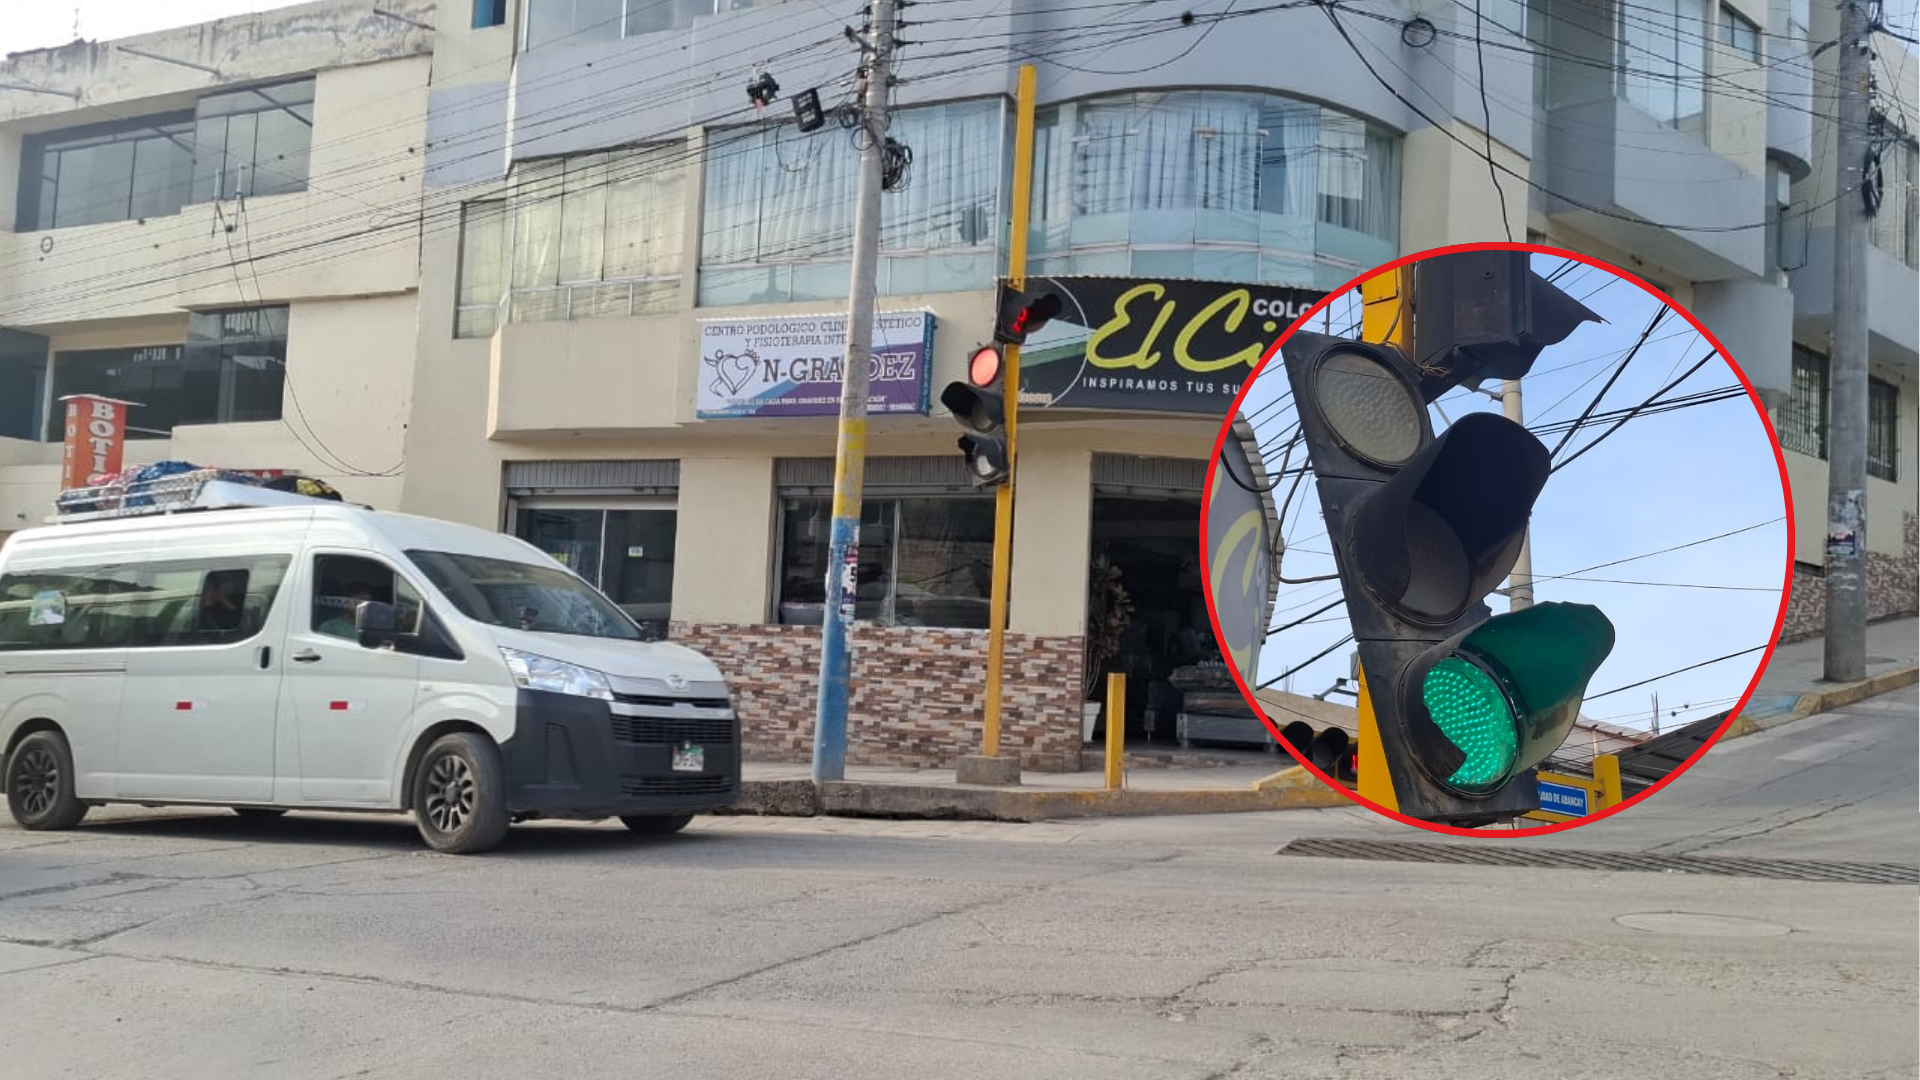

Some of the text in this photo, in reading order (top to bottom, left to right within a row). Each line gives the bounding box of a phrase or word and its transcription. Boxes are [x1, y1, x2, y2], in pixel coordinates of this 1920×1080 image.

[704, 325, 744, 336] CENTRO
[746, 322, 816, 335] PODOLOGICO
[820, 320, 848, 332] CLIN
[1086, 283, 1277, 373] El Ci
[745, 333, 847, 347] Y FISIOTERAPIA INTE
[763, 351, 917, 383] N-GRADEZ
[1082, 376, 1240, 396] INSPIRAMOS TUS SU
[64, 403, 78, 489] BOTI
[1553, 793, 1560, 804] DE
[1561, 794, 1583, 807] ABANCAY
